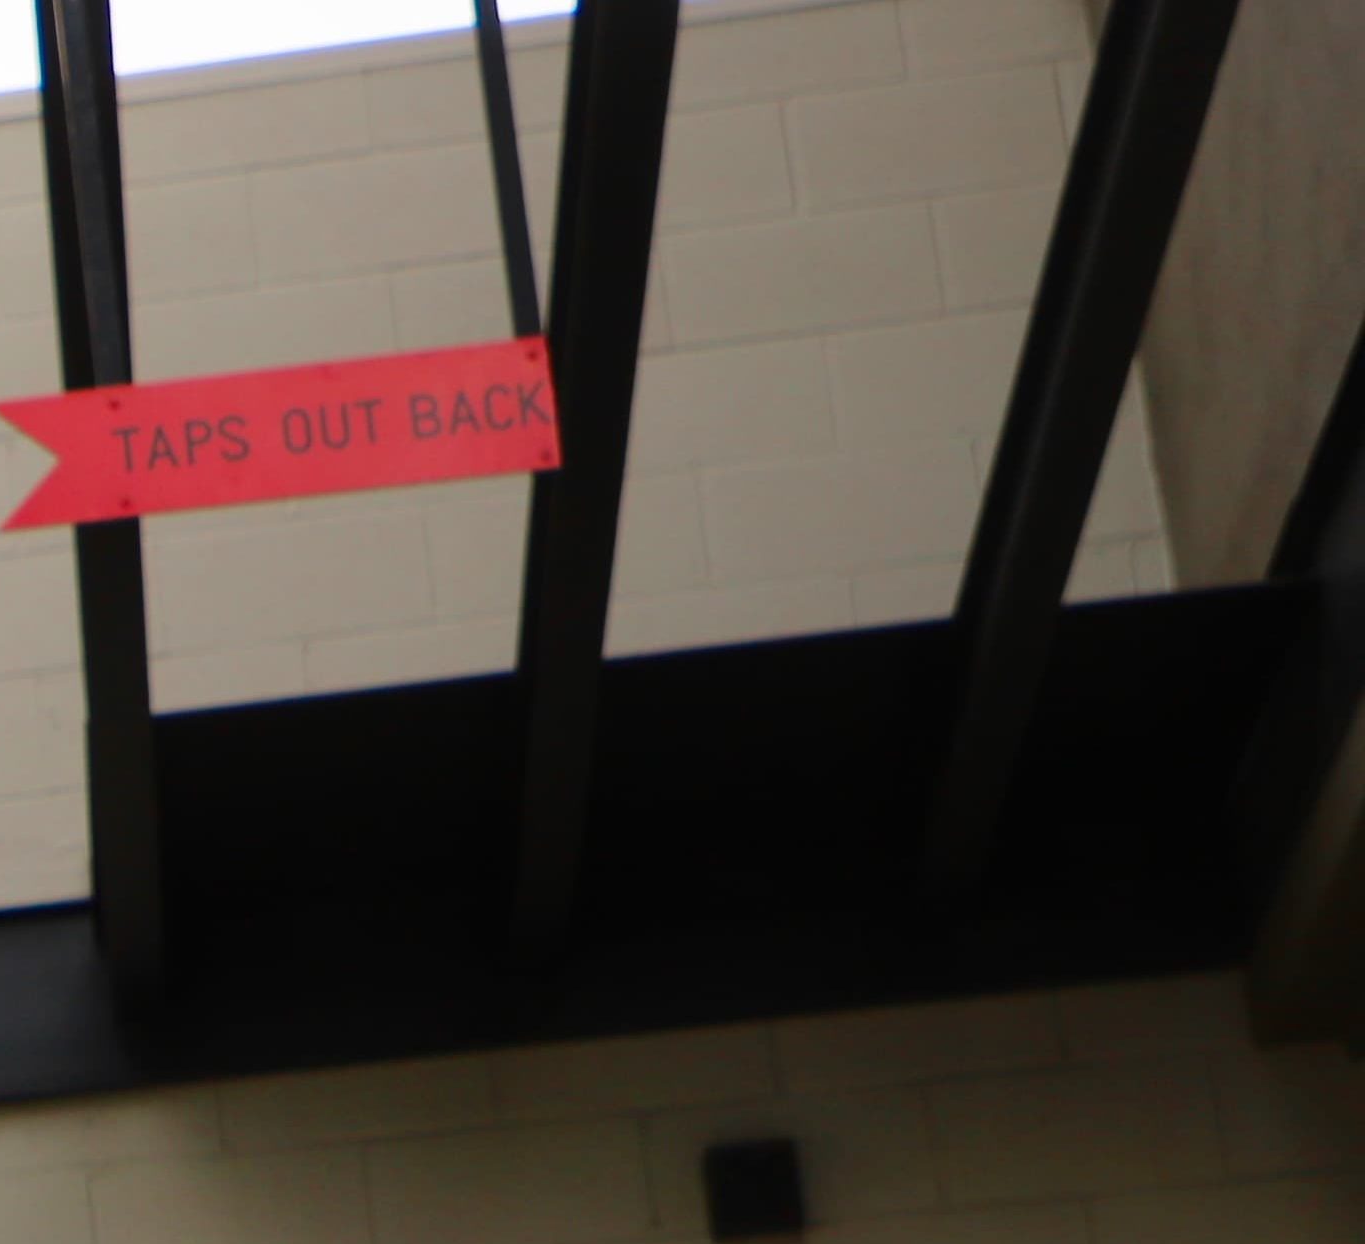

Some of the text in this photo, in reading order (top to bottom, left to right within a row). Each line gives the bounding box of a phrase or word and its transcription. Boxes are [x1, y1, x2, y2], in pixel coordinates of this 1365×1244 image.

[112, 379, 552, 471] TAPS OUT BACK
